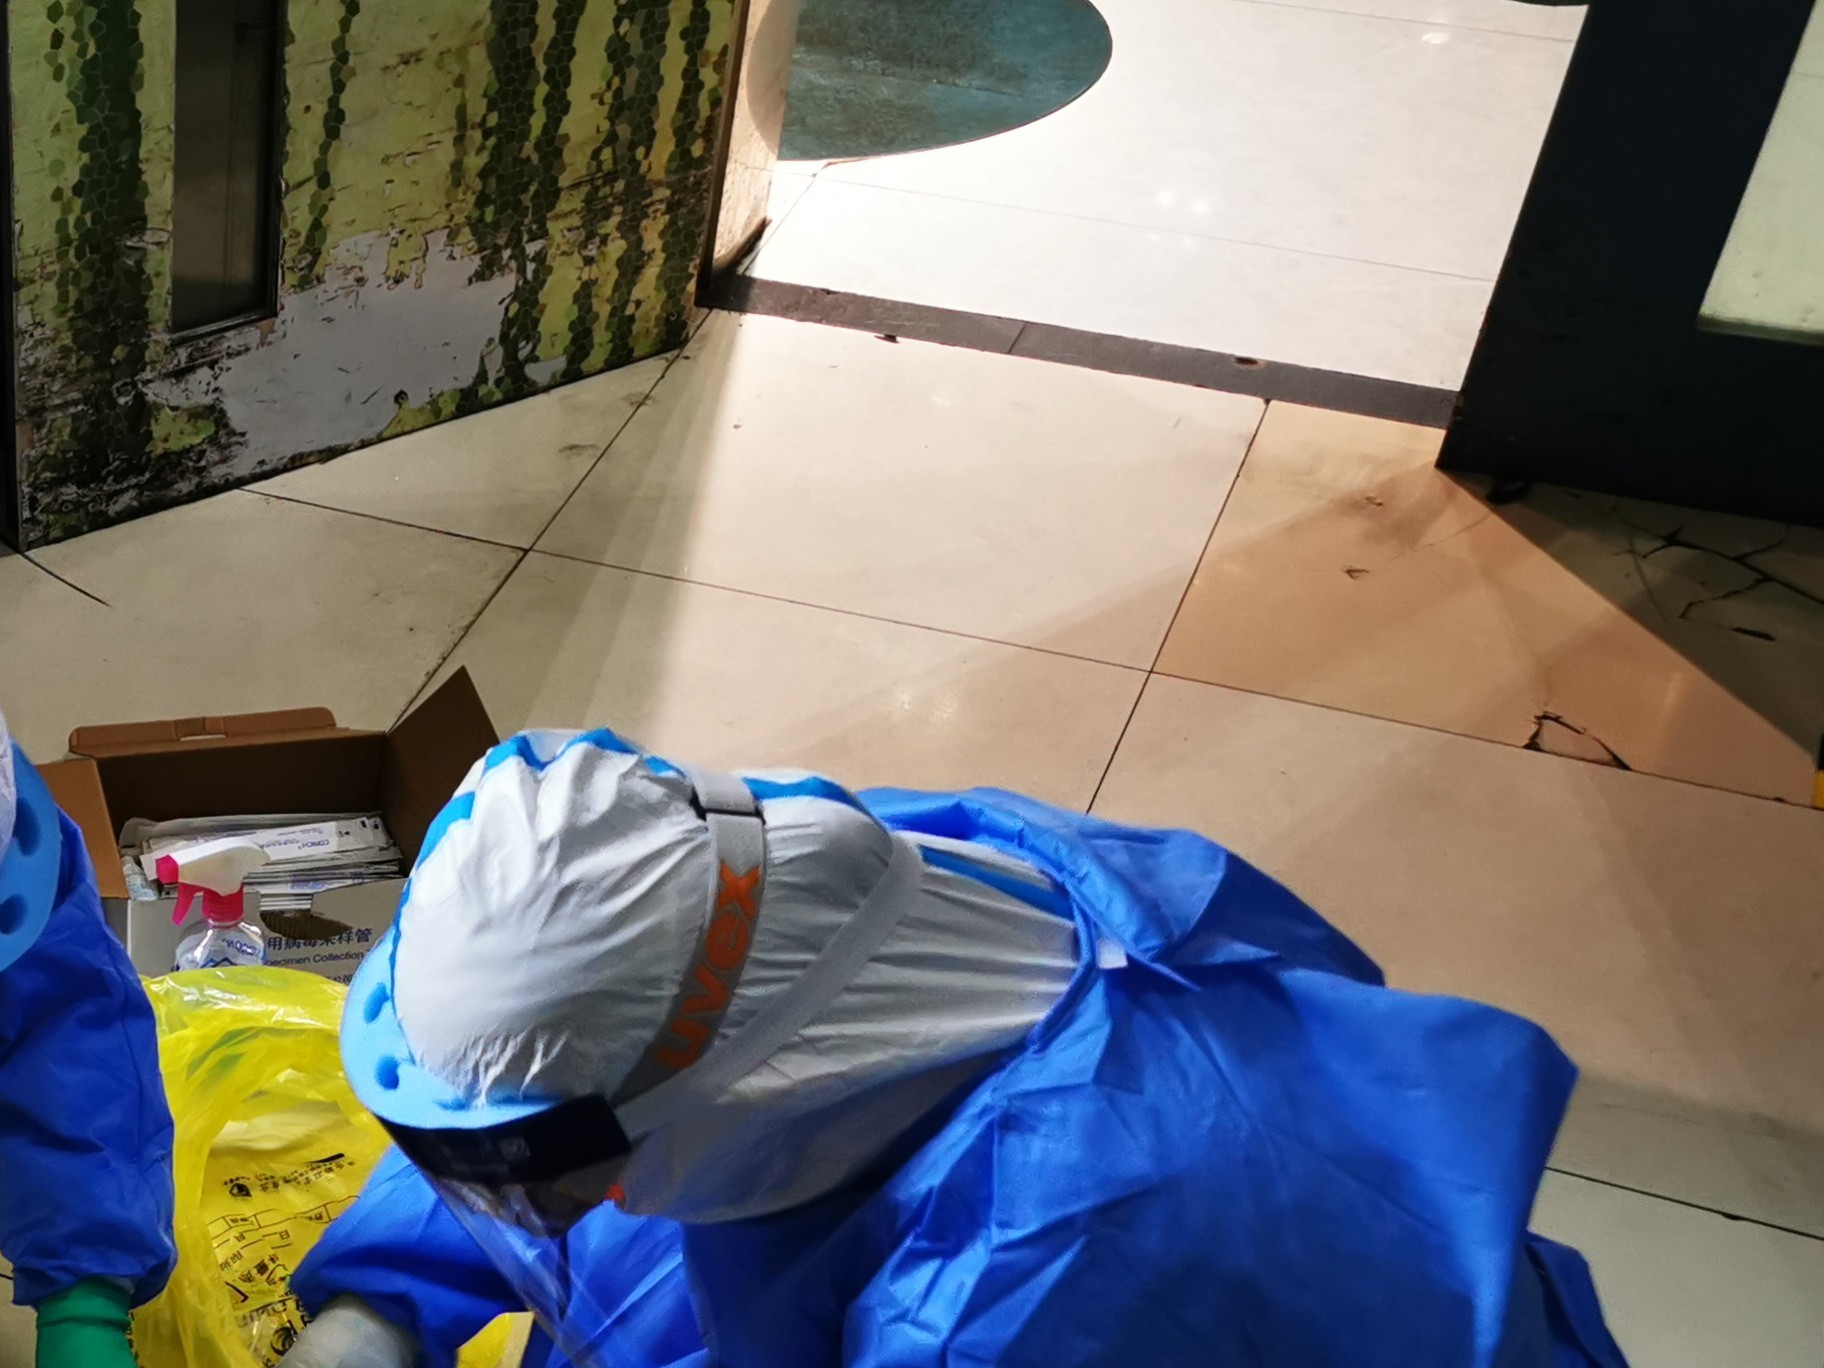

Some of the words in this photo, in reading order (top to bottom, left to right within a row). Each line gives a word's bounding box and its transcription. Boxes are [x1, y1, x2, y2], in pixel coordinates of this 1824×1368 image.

[266, 956, 311, 967] pecimen
[312, 950, 364, 964] Collection
[655, 861, 761, 1069] uvex
